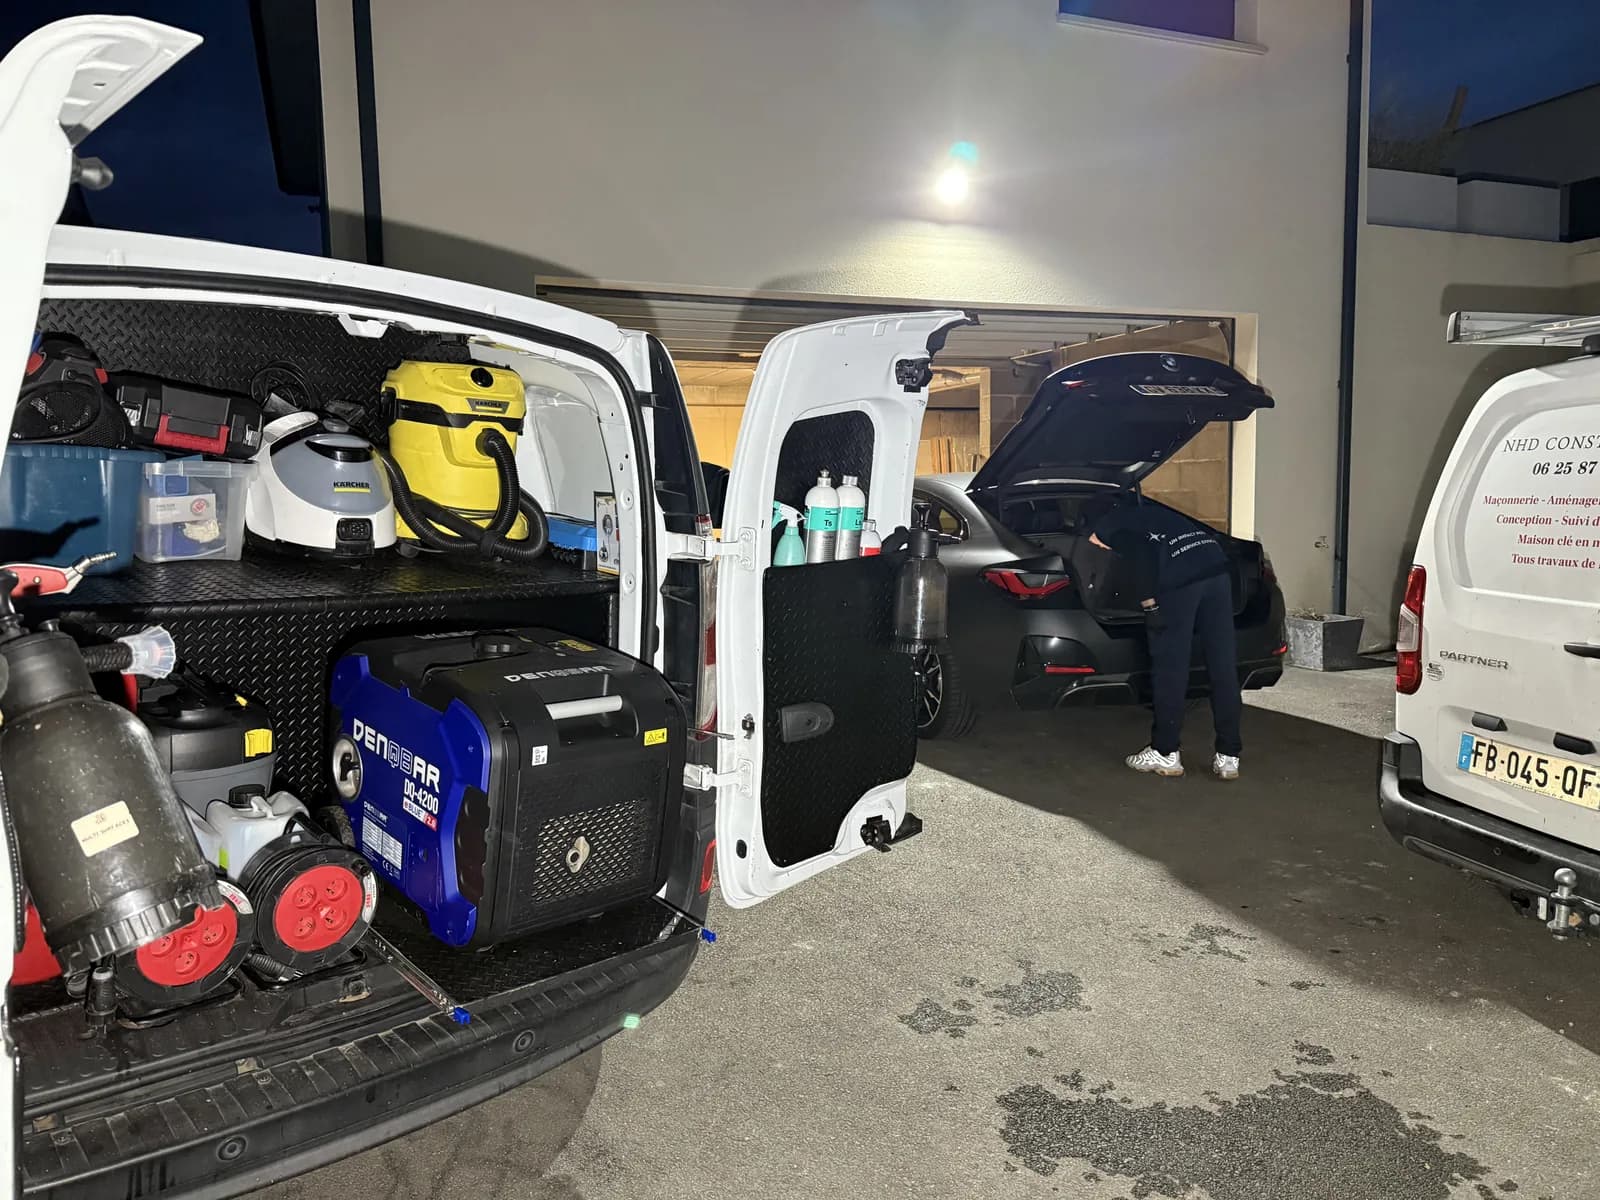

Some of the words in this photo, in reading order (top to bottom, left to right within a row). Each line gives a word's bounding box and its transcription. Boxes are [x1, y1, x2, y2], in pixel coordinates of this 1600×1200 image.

[1503, 438, 1540, 452] NHD
[1532, 462, 1550, 475] 06
[1554, 461, 1573, 475] 25
[1577, 461, 1598, 475] 87
[1483, 495, 1539, 507] Maçonnerie
[1547, 494, 1600, 508] Aménage
[1496, 514, 1552, 527] Conception
[1561, 515, 1590, 526] Suivi
[1180, 541, 1202, 553] SERVICE
[1518, 534, 1554, 545] Maison
[1557, 535, 1573, 546] clé
[1575, 539, 1589, 548] en
[1511, 553, 1536, 565] Tous
[1537, 555, 1579, 568] travaux
[1581, 558, 1596, 569] de
[1439, 650, 1508, 670] PARTNER
[353, 717, 441, 793] DENQBAR
[1472, 741, 1597, 798] FB-045-QF
[404, 778, 439, 815] DQ-4200
